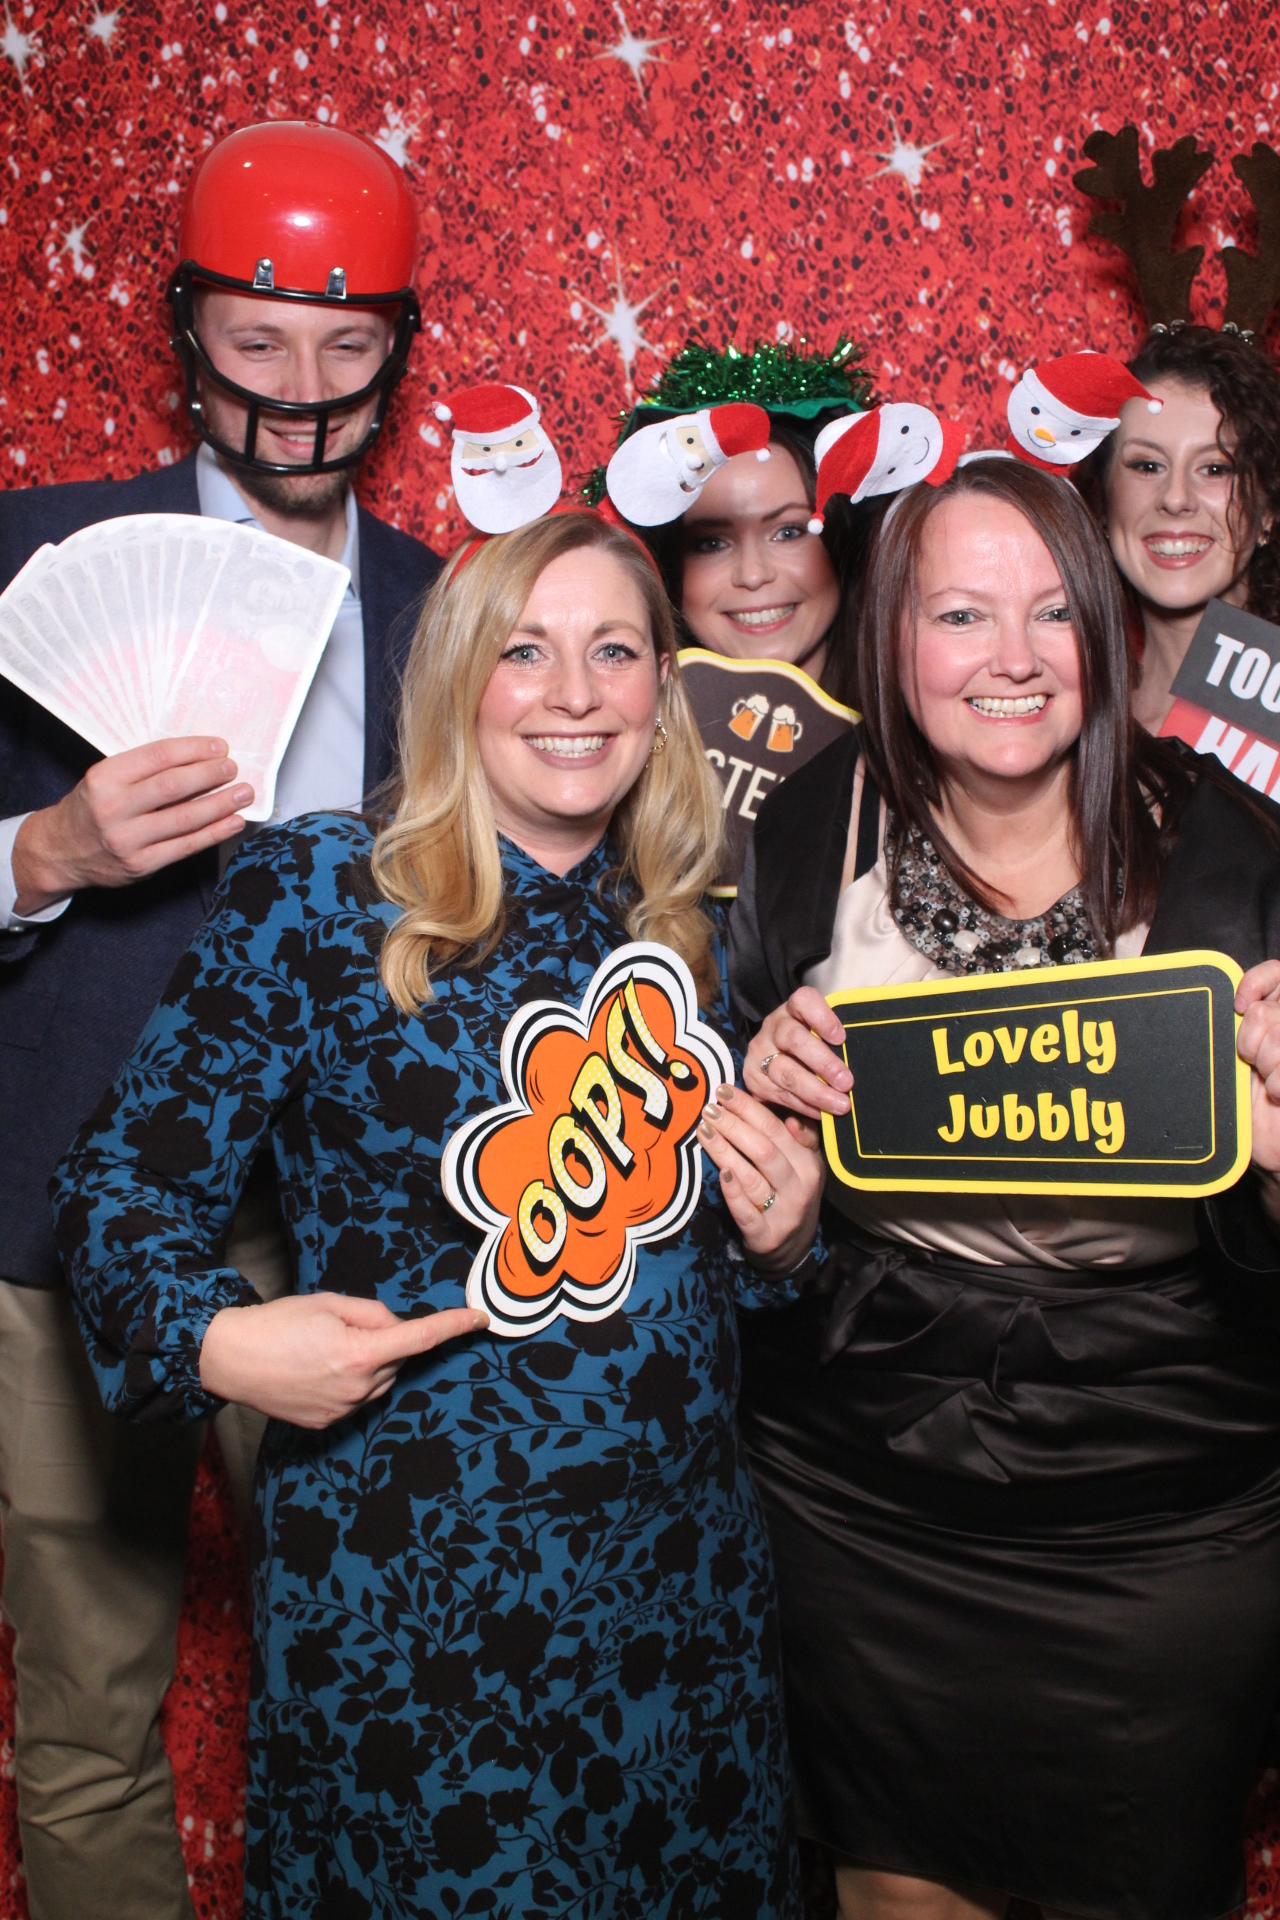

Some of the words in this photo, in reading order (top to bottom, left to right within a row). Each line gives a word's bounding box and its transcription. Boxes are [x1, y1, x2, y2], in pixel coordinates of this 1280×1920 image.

[704, 748, 785, 820] TE
[1194, 715, 1280, 804] HA
[932, 1009, 1117, 1074] Lovely
[517, 970, 698, 1275] OOPS!
[937, 1087, 1125, 1154] Jubbly
